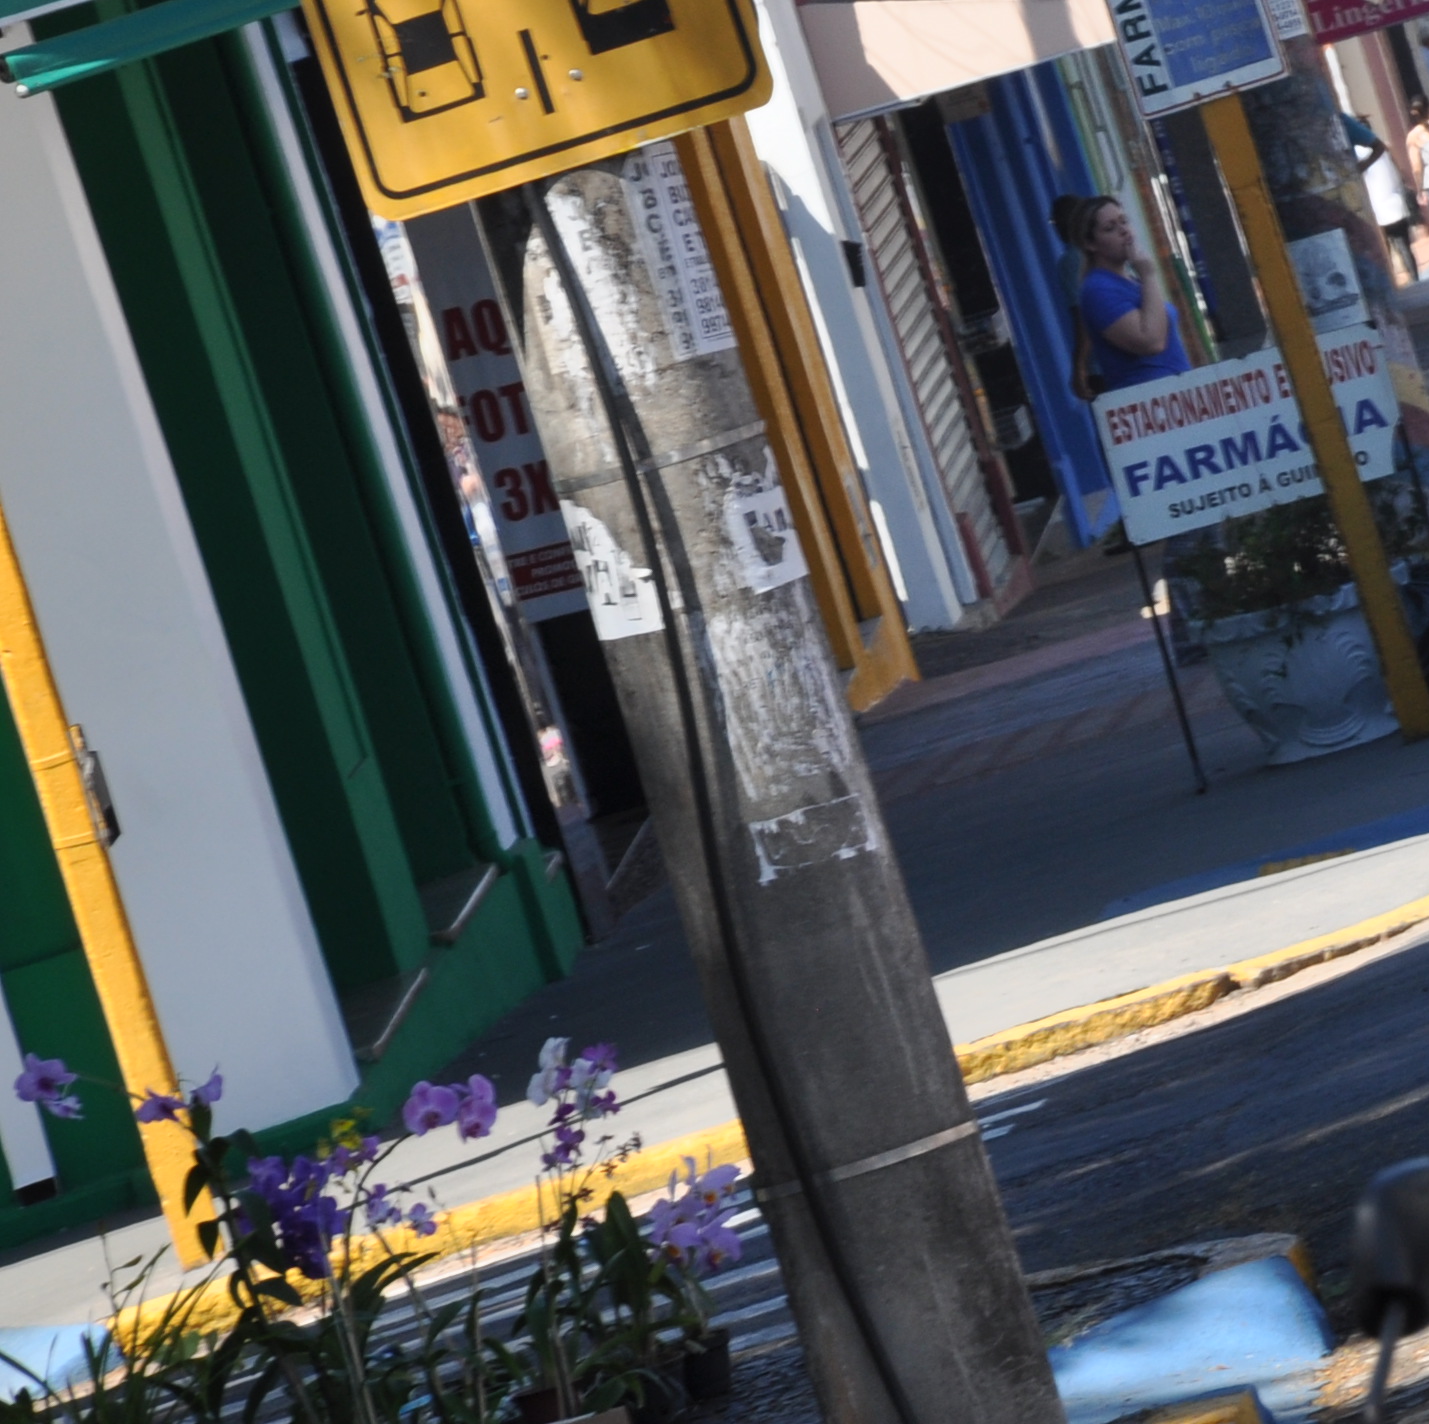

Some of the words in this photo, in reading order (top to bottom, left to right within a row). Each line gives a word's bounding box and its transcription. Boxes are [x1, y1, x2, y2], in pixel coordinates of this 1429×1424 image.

[443, 298, 510, 362] AQ
[1103, 367, 1273, 445] ESTACIONAMENTO
[1119, 388, 1388, 498] FARMÁA
[1166, 481, 1253, 519] SUJEITO
